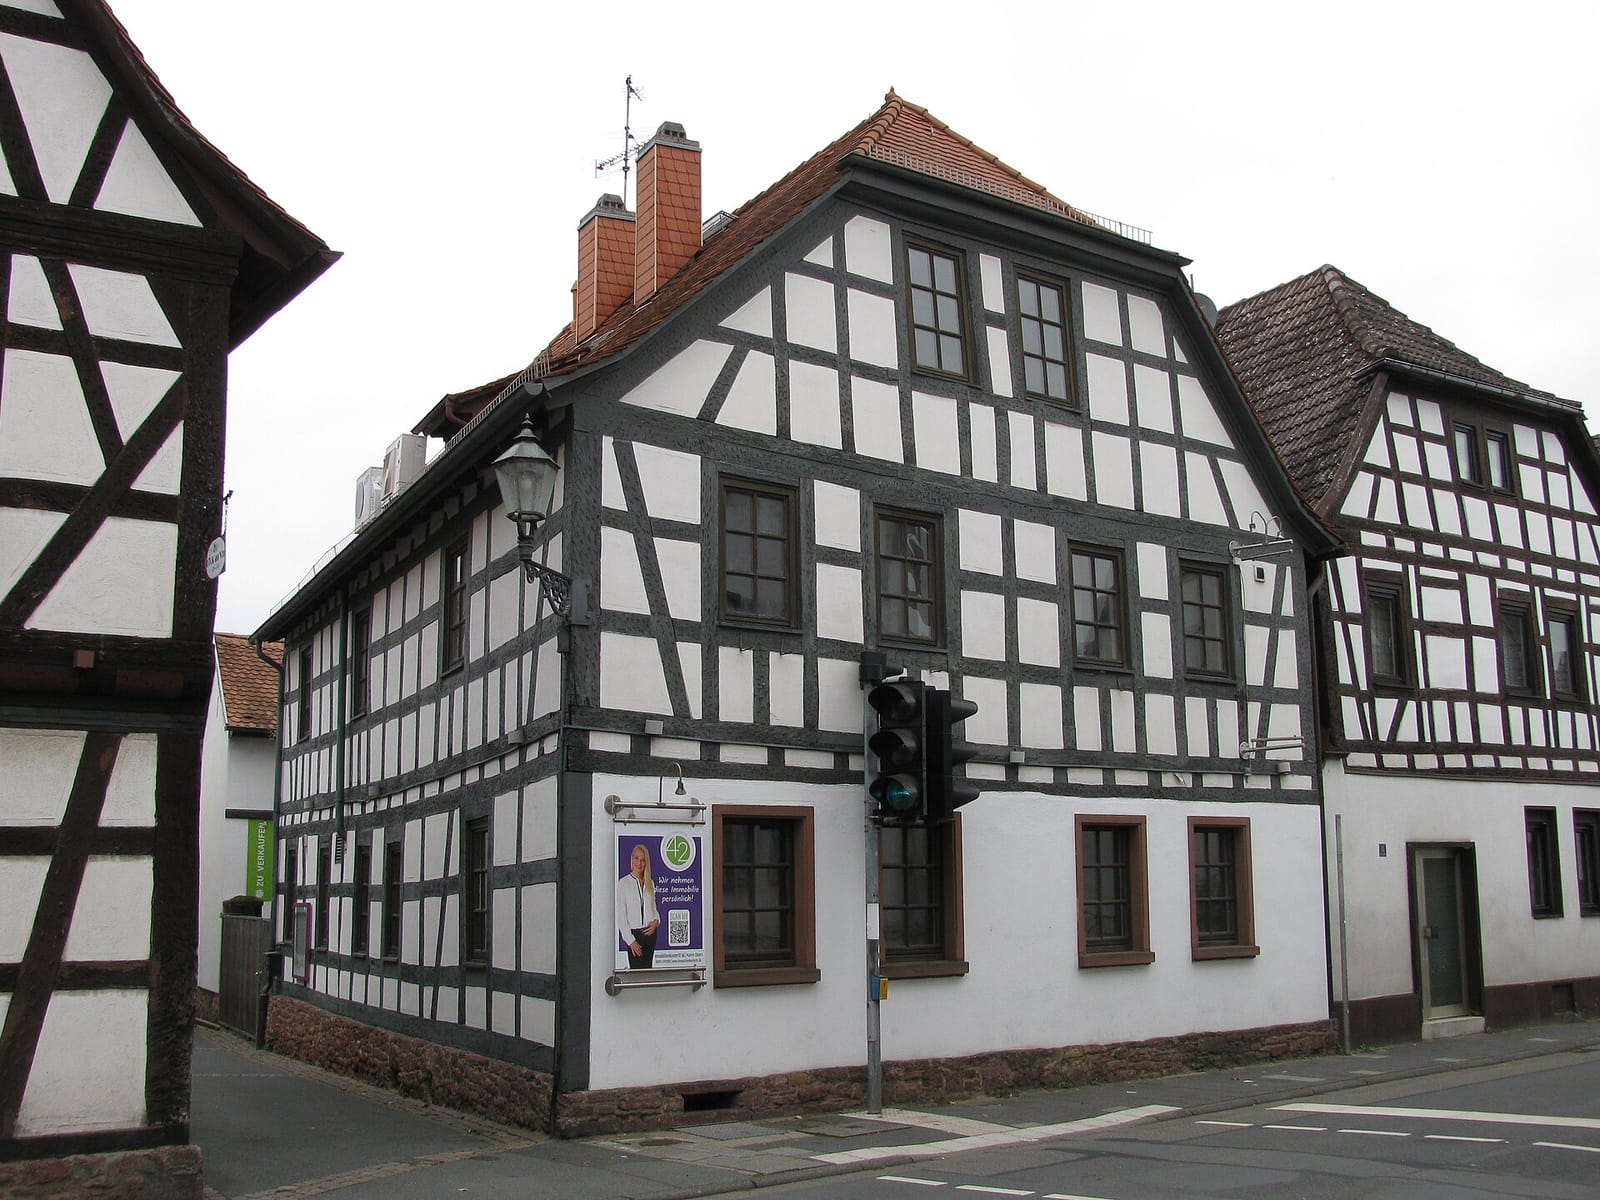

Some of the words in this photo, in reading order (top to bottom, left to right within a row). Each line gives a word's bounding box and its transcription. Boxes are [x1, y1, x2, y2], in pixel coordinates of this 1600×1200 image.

[257, 822, 265, 872] VERKAUFEN
[665, 836, 689, 862] 42
[257, 875, 264, 887] ZU
[658, 876, 669, 884] Wir
[670, 876, 695, 884] nehmen
[670, 885, 700, 893] Immobilie
[661, 894, 694, 904] persönlich!
